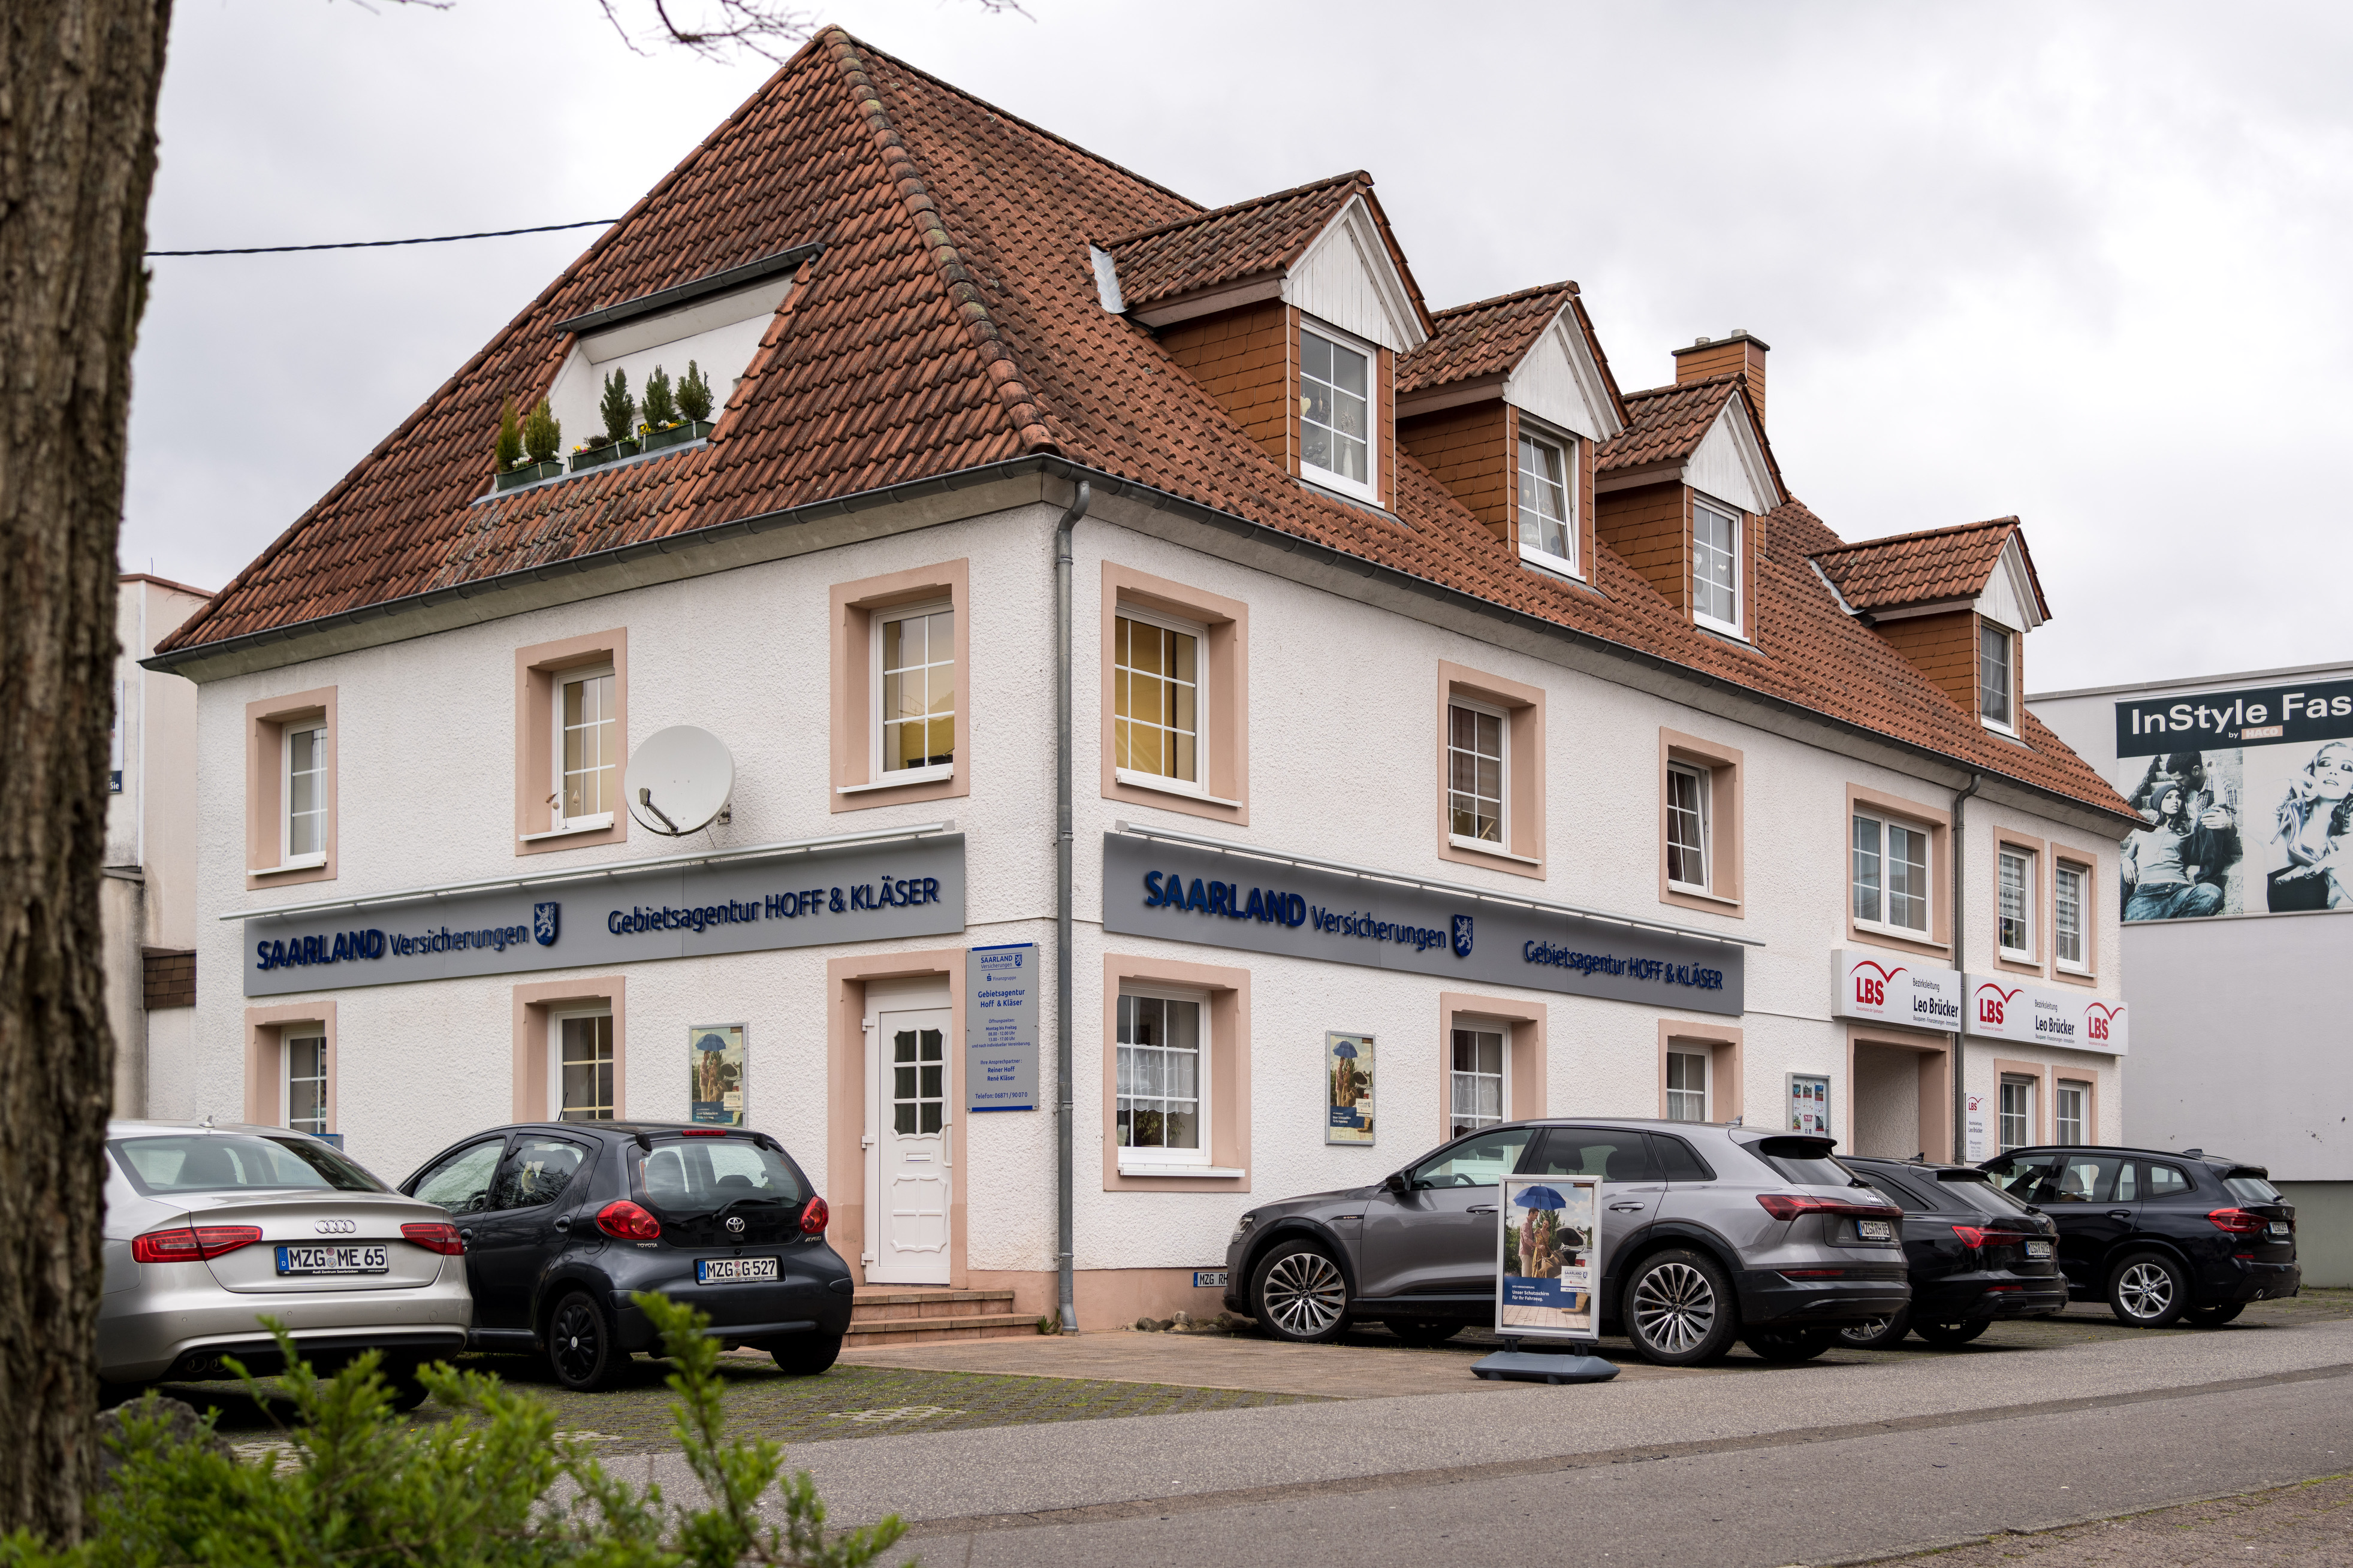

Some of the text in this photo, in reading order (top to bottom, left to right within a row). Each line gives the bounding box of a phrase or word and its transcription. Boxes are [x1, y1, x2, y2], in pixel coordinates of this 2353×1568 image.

[2132, 699, 2267, 735] InStyle
[2228, 727, 2278, 739] by HACO
[608, 875, 938, 934] Gebietsagentur HOFF & KLÄSER
[1147, 870, 1447, 951] SAARLAND Versicherungen
[257, 925, 527, 969] SAARLAND Versicherungen
[1525, 940, 1723, 990] Gebietsagentur HOFF & KLÄSER
[978, 989, 1025, 998] Gebietsagentur
[1857, 977, 1884, 1005] LBS
[1913, 978, 1939, 992] Bezirksleitung
[1914, 995, 1959, 1018] Leo Brücker
[1980, 998, 2004, 1024] LBS
[2035, 999, 2058, 1013] Bezirksleitung
[2035, 1015, 2074, 1035] Leo Brücker
[2088, 1016, 2108, 1040] LBS
[1968, 1102, 1977, 1111] LBS
[1861, 1222, 1872, 1234] MZG
[1874, 1223, 1882, 1235] RH
[1882, 1223, 1889, 1235] 8E
[289, 1249, 326, 1268] MZG
[337, 1249, 361, 1267] ME
[364, 1249, 385, 1266] 65
[707, 1262, 733, 1277] MZG
[742, 1261, 750, 1276] G
[753, 1260, 775, 1276] 527
[1200, 1274, 1214, 1285] MZG
[1219, 1274, 1228, 1285] RH
